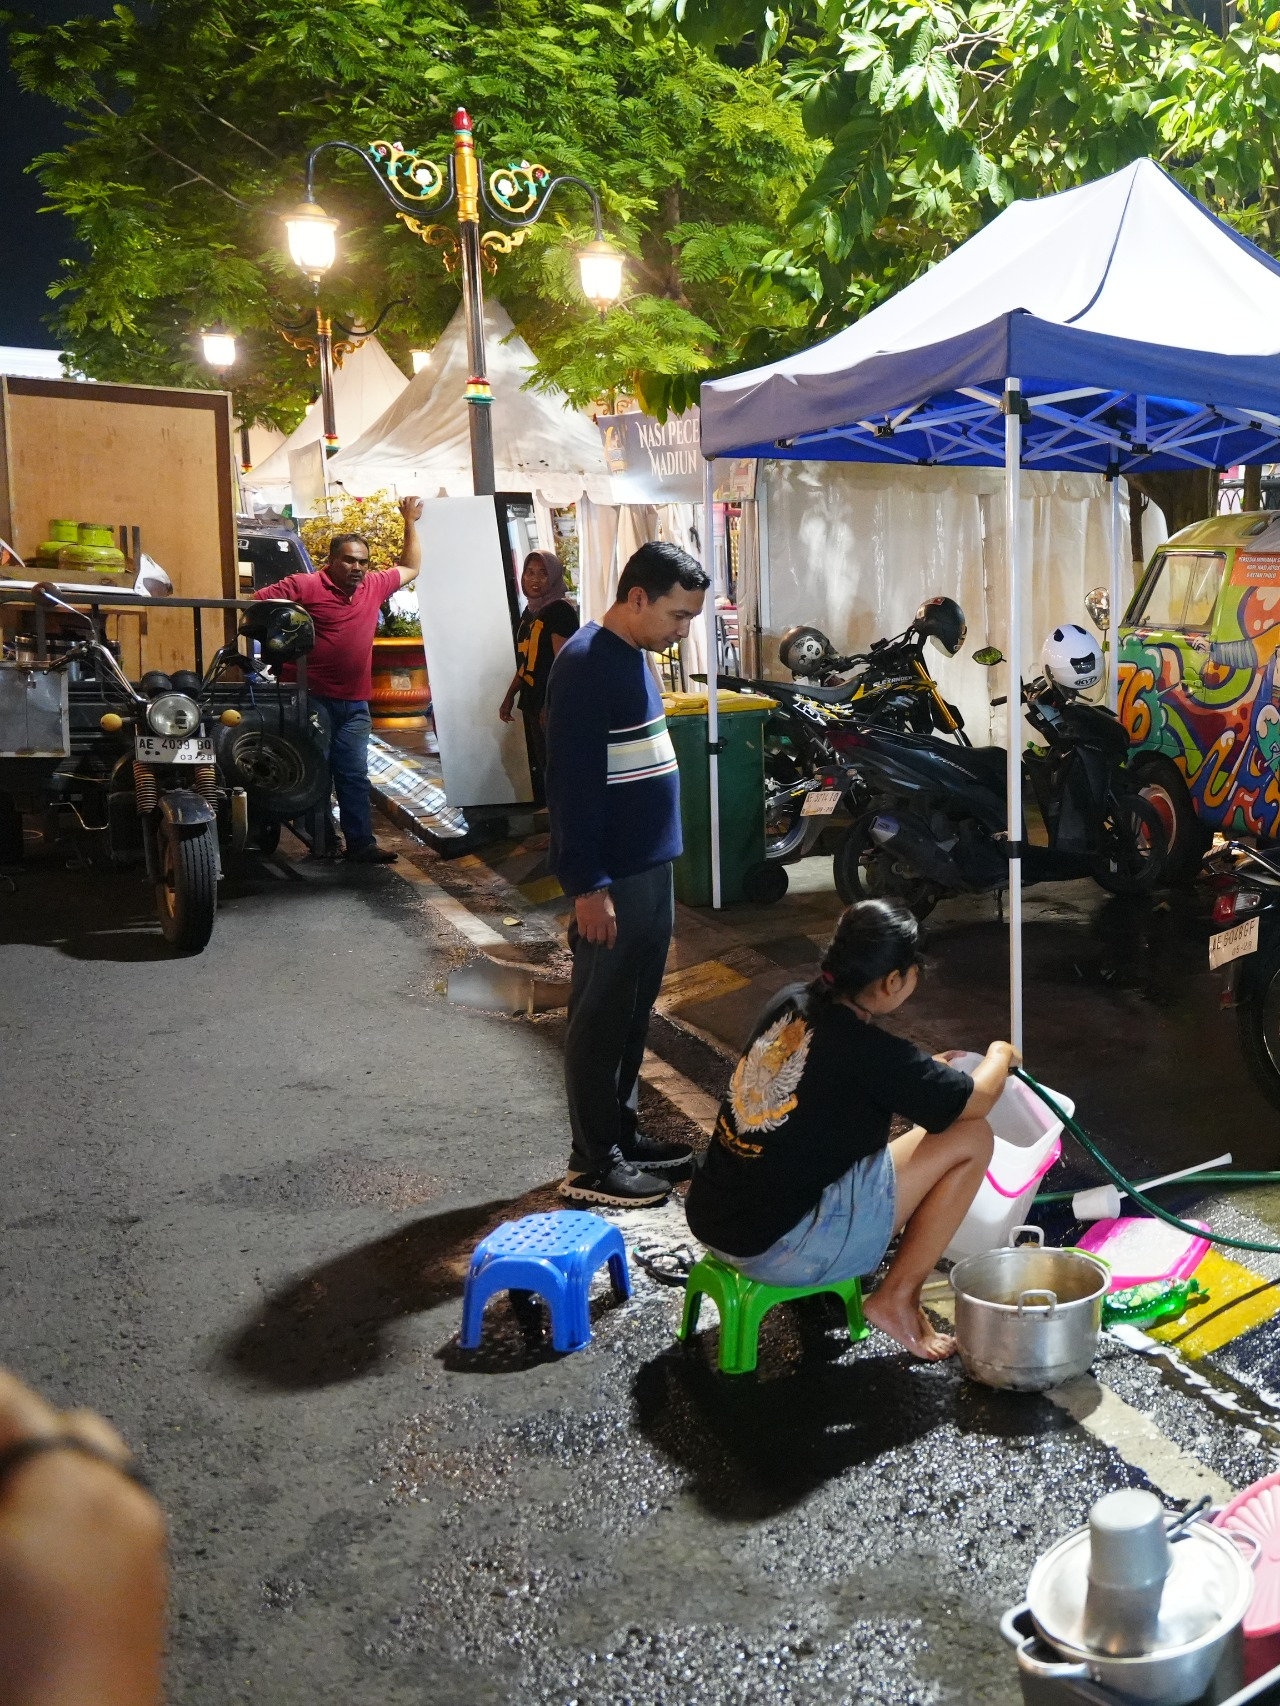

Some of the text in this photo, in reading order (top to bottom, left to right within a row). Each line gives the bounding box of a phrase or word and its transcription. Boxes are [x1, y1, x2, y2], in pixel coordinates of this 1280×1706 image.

[635, 421, 666, 450] NASI
[649, 450, 697, 482] MADIUN
[139, 738, 154, 750] AE
[161, 739, 190, 750] 4039
